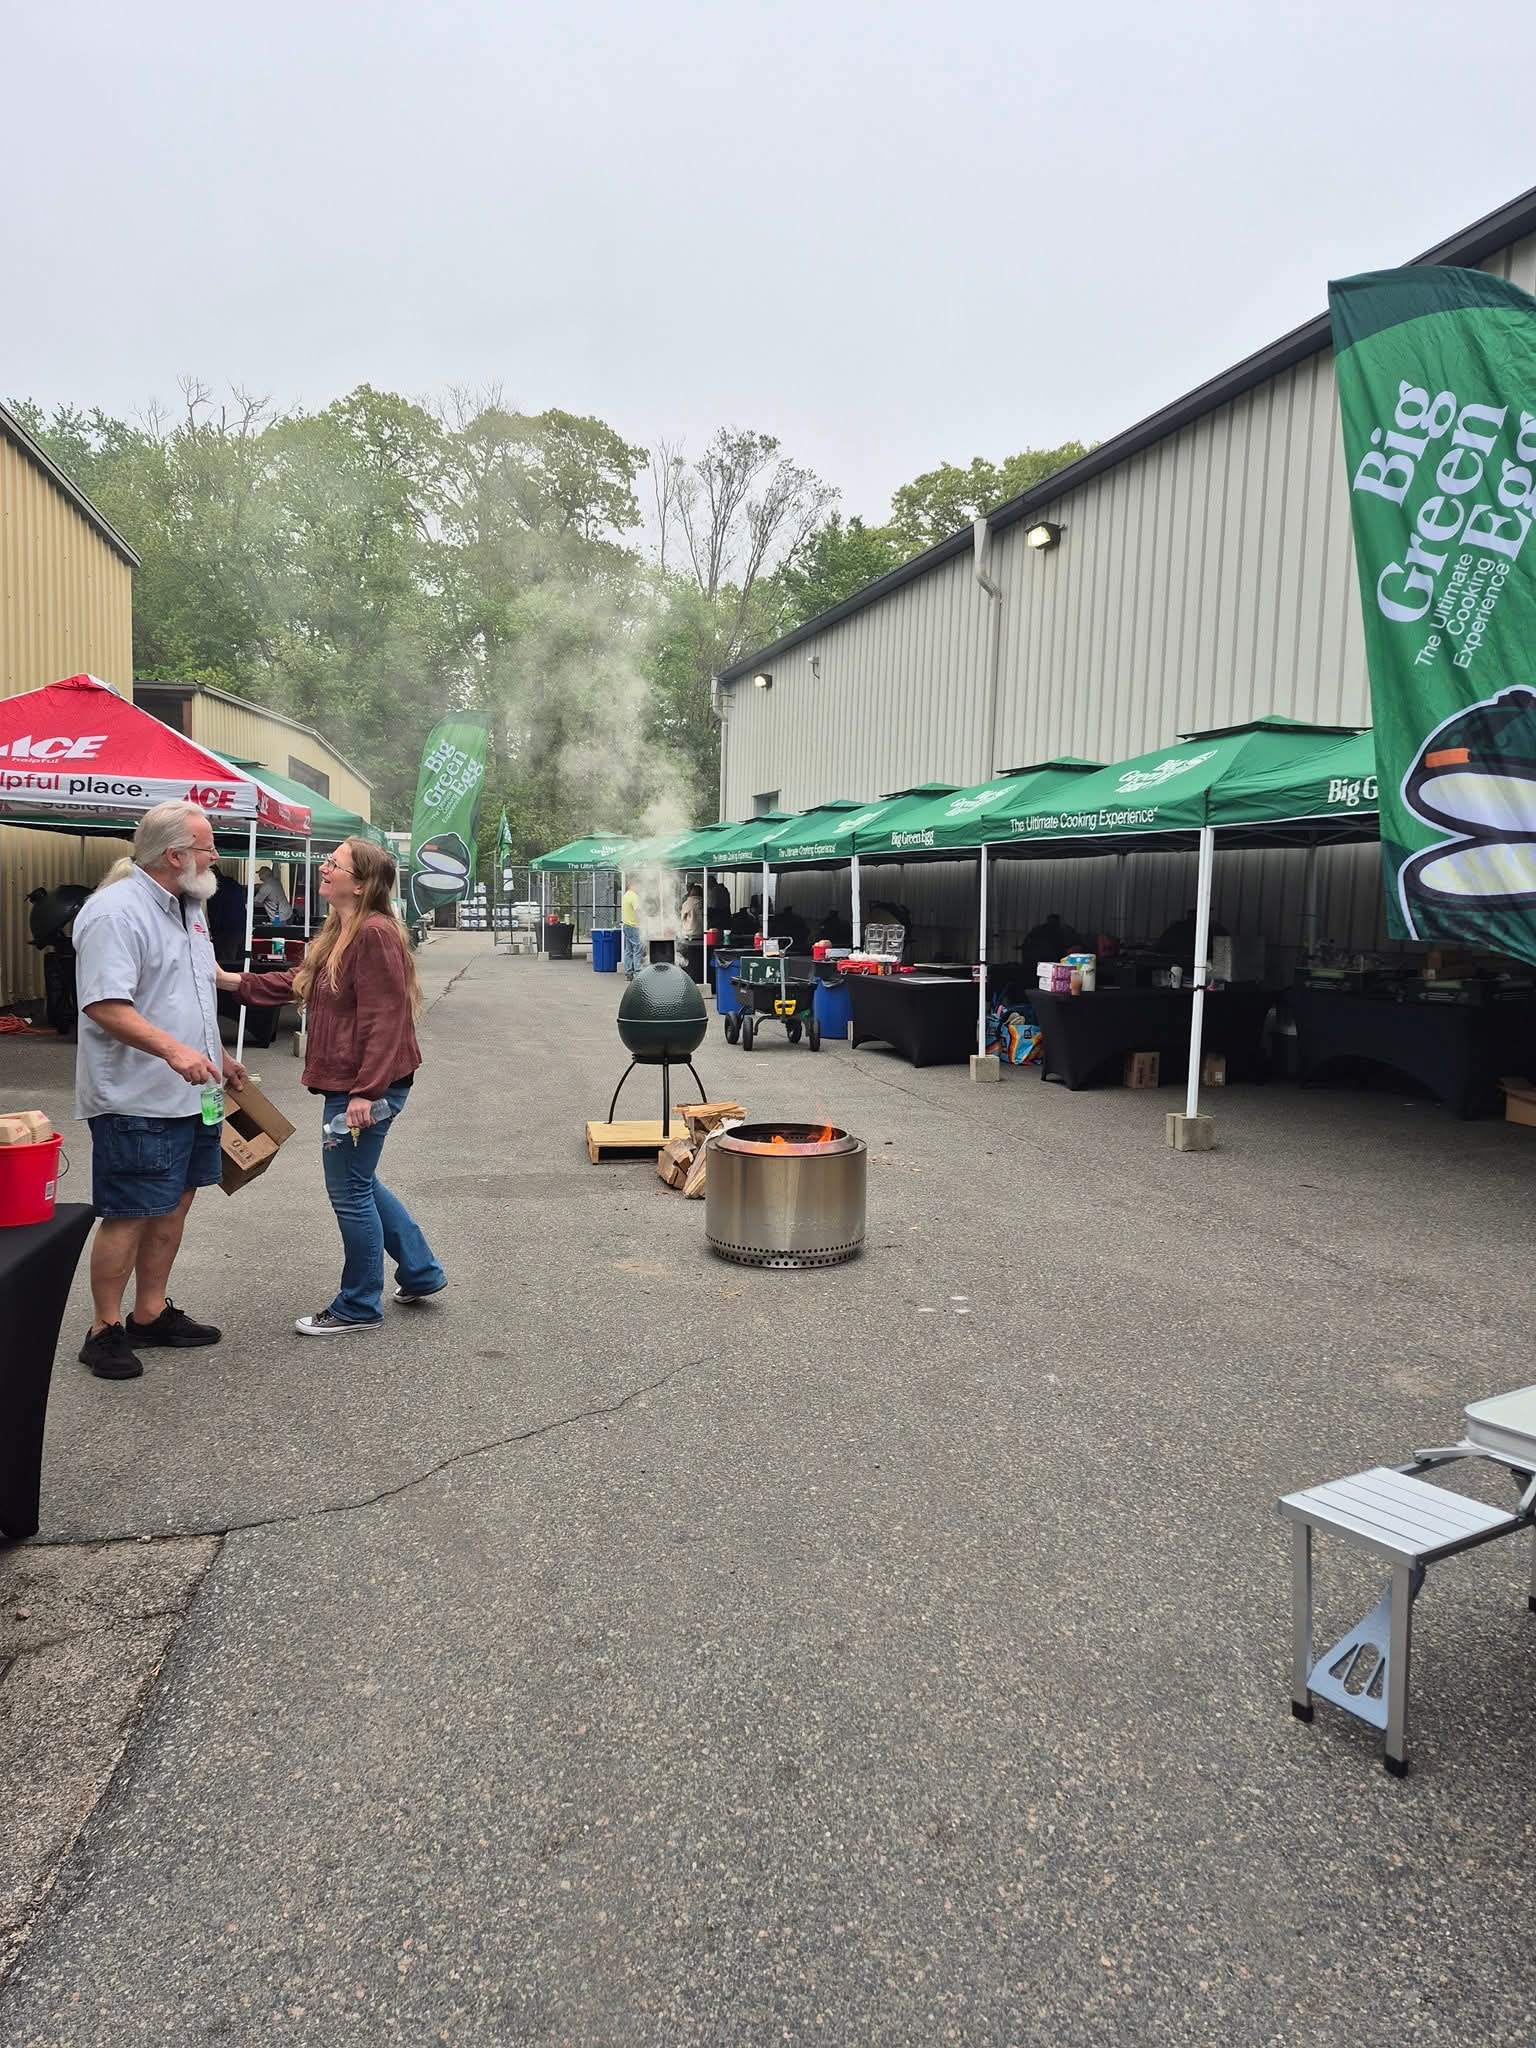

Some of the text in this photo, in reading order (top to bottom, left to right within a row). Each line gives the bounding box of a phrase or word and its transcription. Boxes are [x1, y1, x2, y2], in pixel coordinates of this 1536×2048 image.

[1353, 379, 1457, 508] Big
[1377, 403, 1509, 623] Green
[1414, 553, 1473, 667] The Ultimate
[1446, 558, 1496, 636] Cooking
[1452, 562, 1510, 669] Experience
[0, 734, 108, 759] ACE
[424, 739, 455, 774] Big
[0, 771, 149, 797] lpful place.
[182, 784, 236, 809] ACE
[423, 751, 468, 806] Green
[449, 758, 483, 797] Egg
[1327, 778, 1361, 807] Big
[1010, 819, 1024, 832] The
[1026, 816, 1059, 831] Ultimate
[1060, 812, 1097, 830] Cooking
